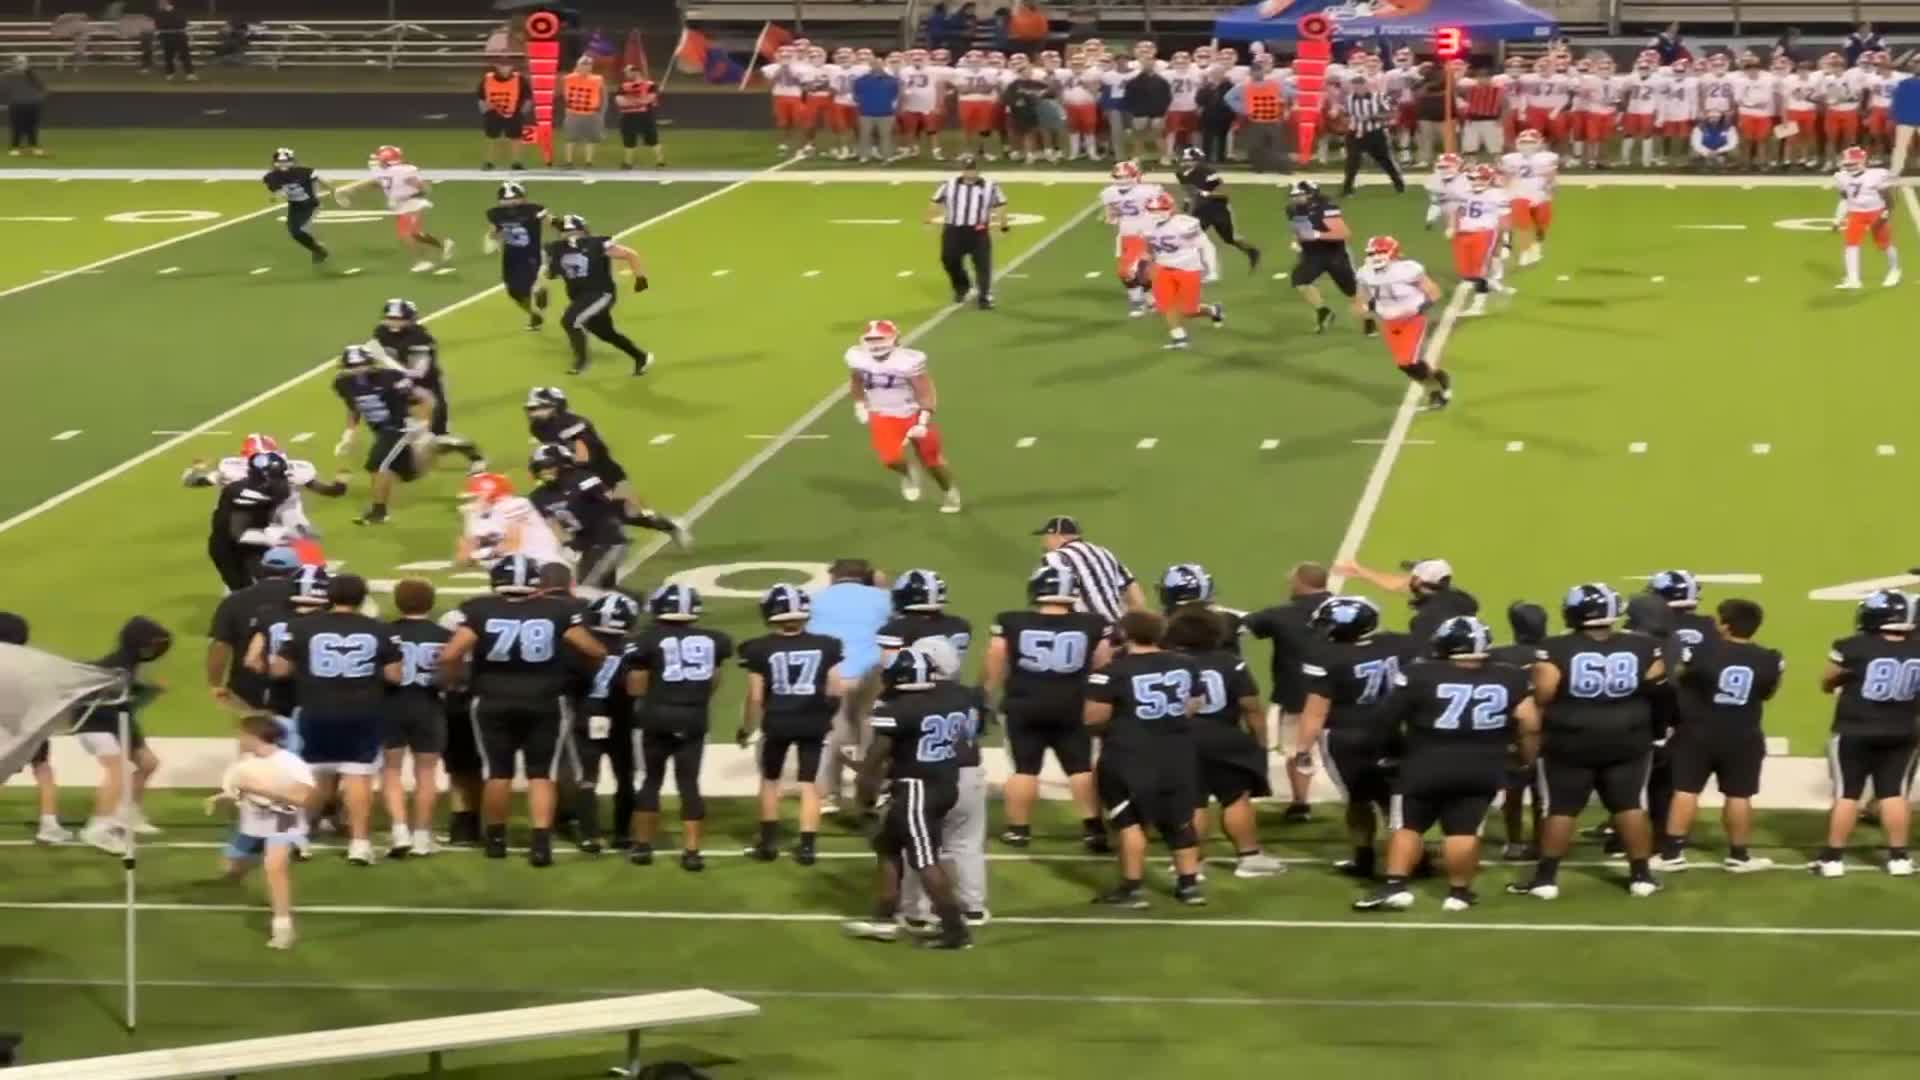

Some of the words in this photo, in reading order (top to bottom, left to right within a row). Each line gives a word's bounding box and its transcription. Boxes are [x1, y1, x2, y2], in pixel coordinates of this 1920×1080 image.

[1438, 27, 1460, 53] 3
[309, 632, 378, 678] 62
[485, 618, 555, 663] 78
[658, 635, 716, 682] 19
[1018, 629, 1089, 673] 50
[768, 649, 822, 695] 17
[1131, 669, 1192, 719] 53
[1569, 651, 1638, 698] 68
[1713, 665, 1754, 705] 9
[1433, 682, 1509, 730] 72
